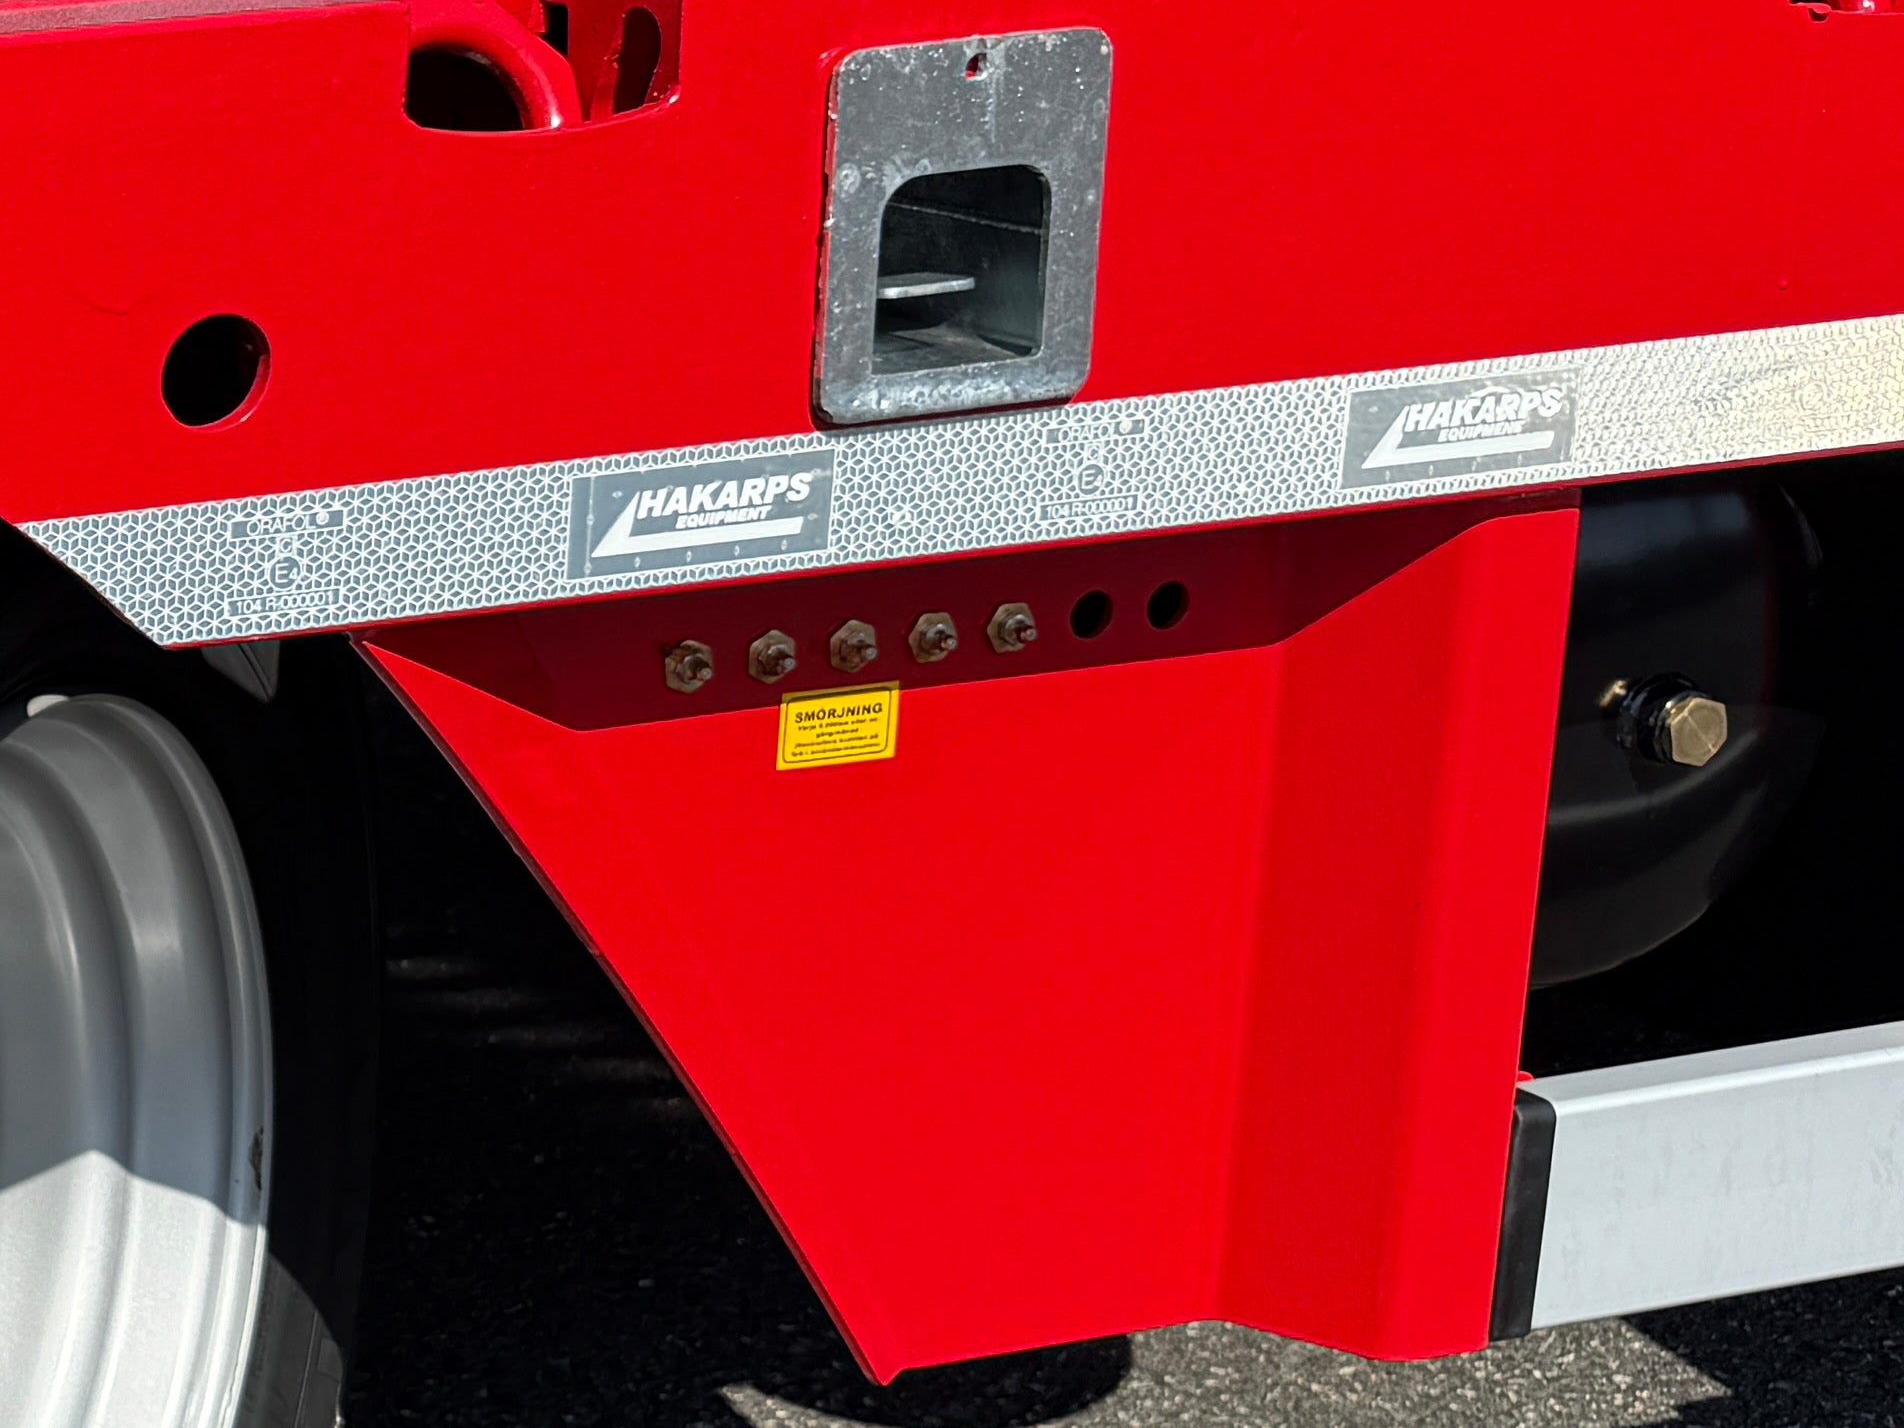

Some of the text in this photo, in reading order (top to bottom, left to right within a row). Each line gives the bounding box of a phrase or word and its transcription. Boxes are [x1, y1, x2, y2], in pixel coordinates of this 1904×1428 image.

[1404, 387, 1563, 433] HAKARPS
[1438, 419, 1525, 443] EQUIPMENT
[636, 472, 814, 520] HAKARPS
[675, 505, 774, 530] EQUIPMENT
